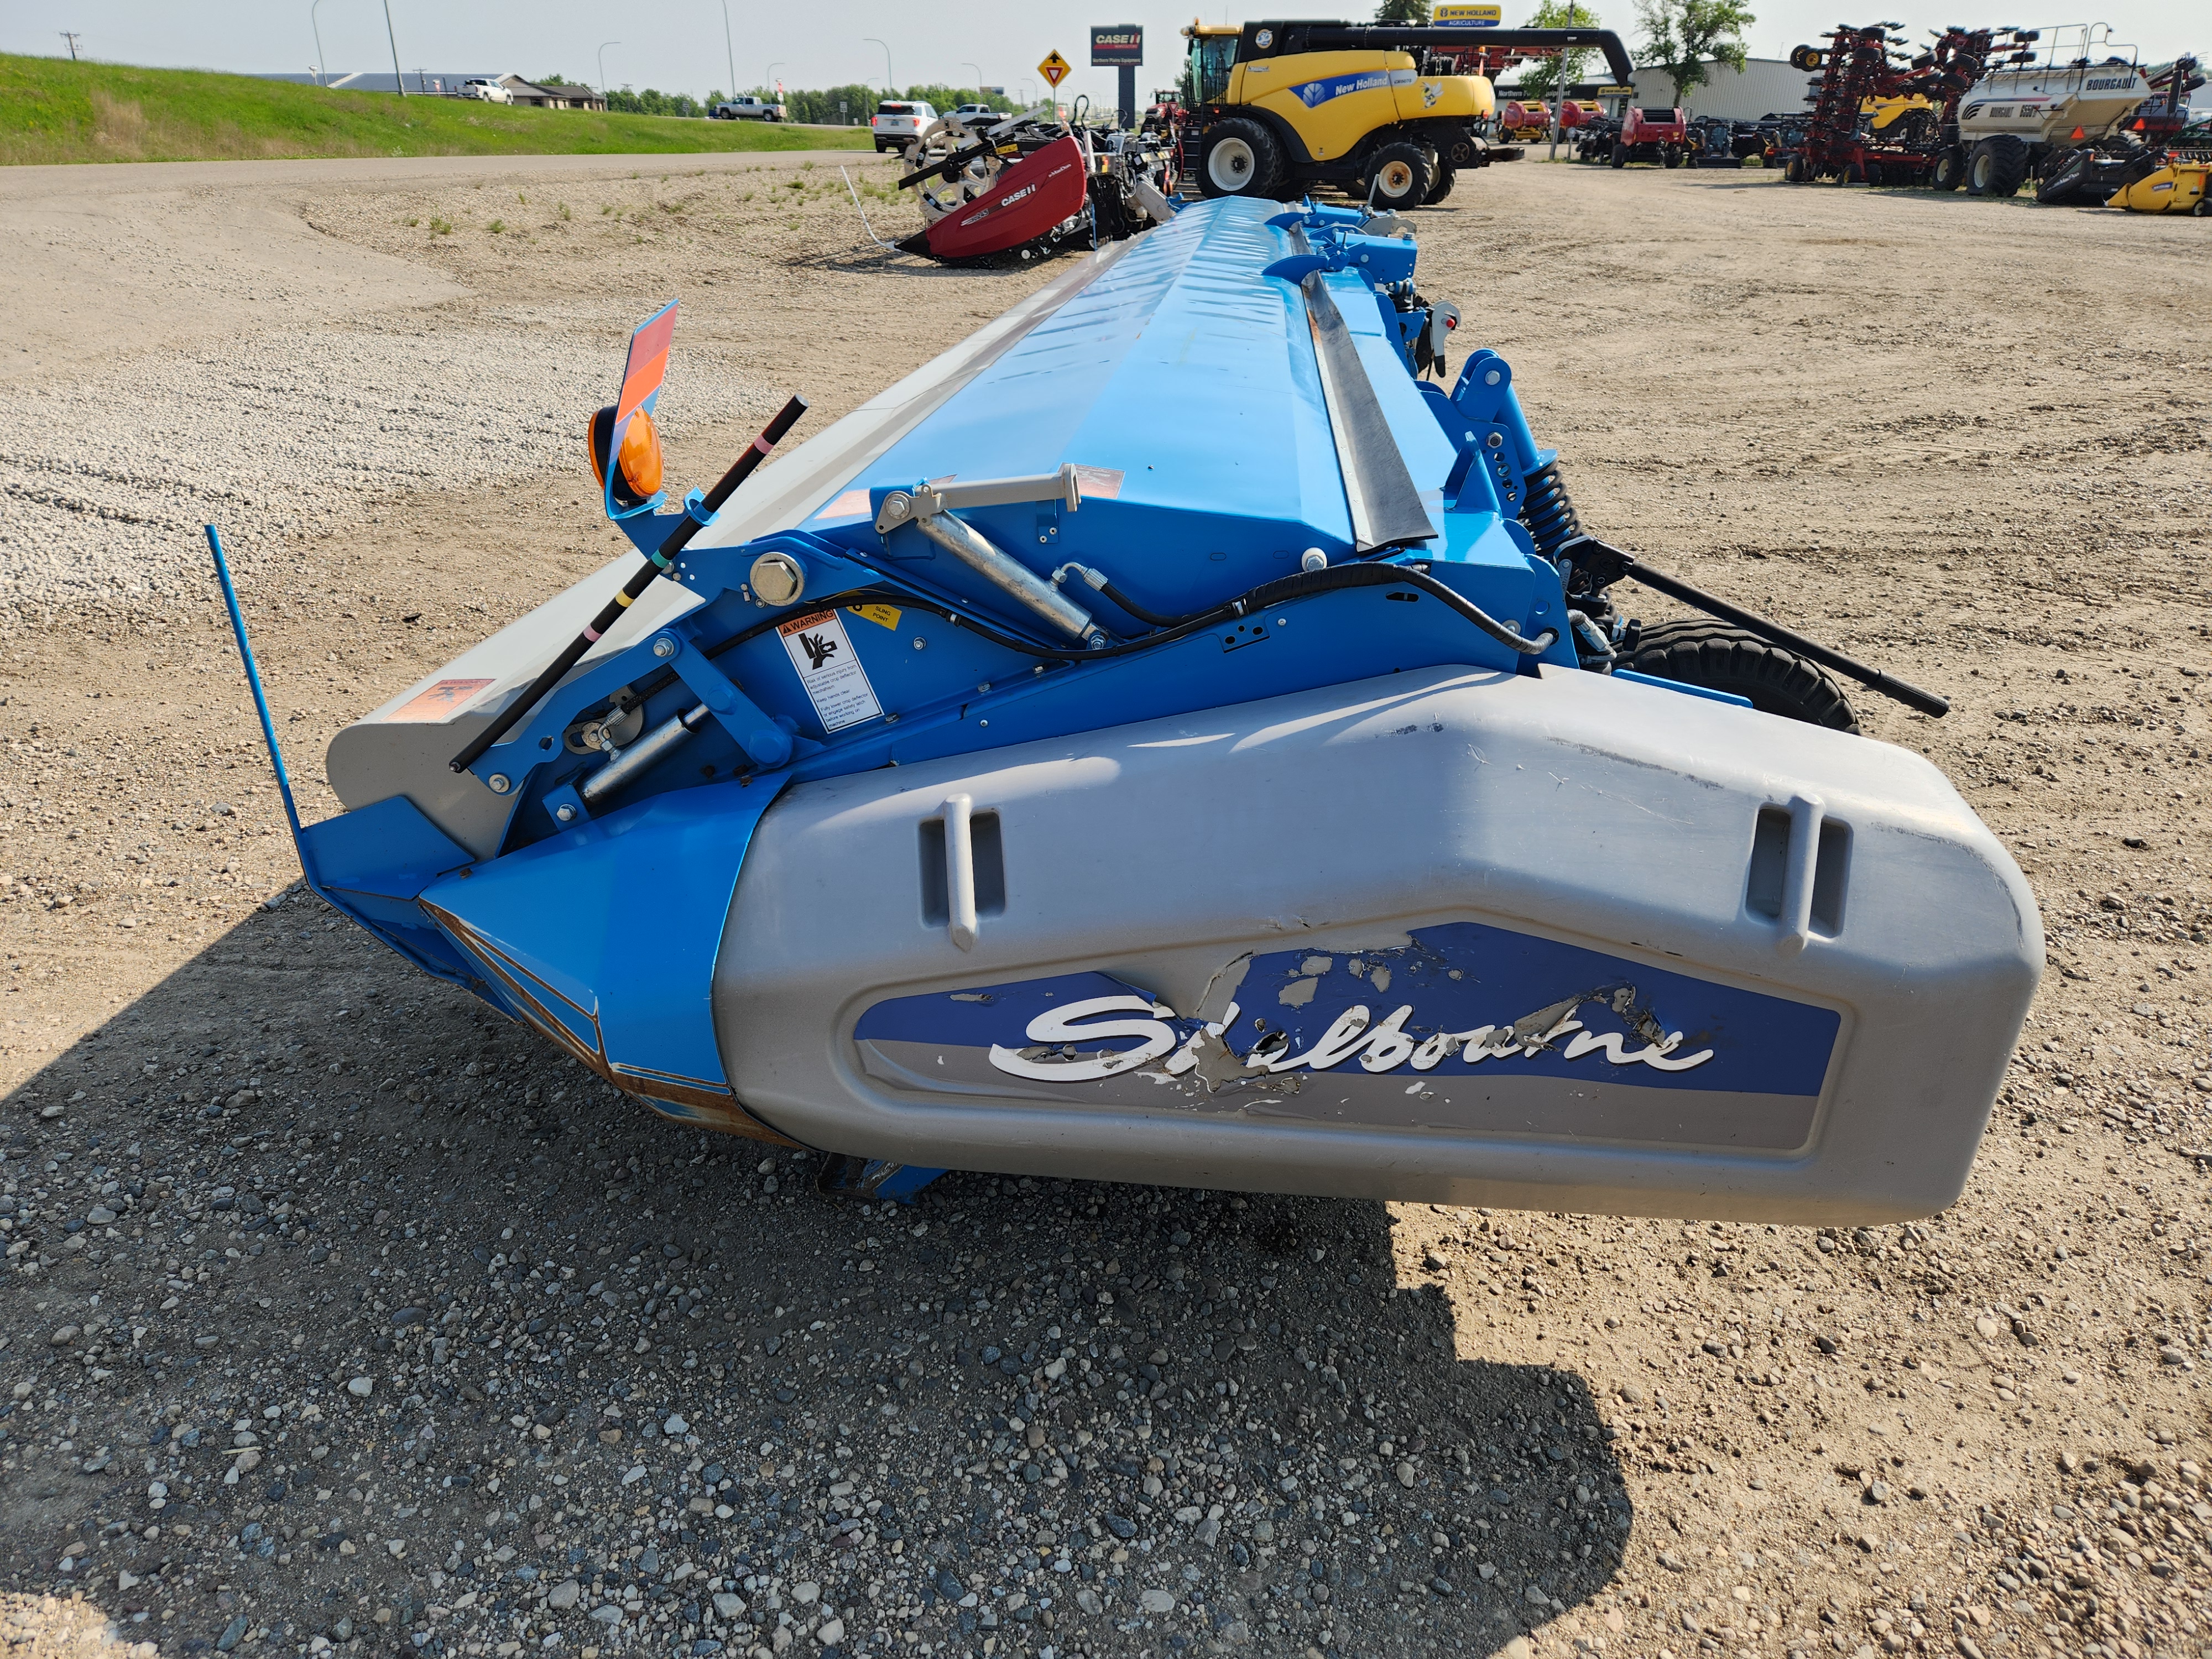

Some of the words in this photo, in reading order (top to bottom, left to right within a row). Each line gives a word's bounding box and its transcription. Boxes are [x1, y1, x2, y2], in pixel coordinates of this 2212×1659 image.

[1095, 34, 1129, 44] CASE
[1335, 83, 1355, 96] New
[1356, 75, 1388, 90] Holland
[2086, 77, 2138, 91] BOURGAULT
[1052, 163, 1072, 176] MacDon
[1001, 188, 1027, 207] CASE
[875, 606, 891, 616] SLING
[790, 610, 833, 630] WARNING
[873, 612, 889, 622] POINT
[836, 667, 847, 676] injury
[810, 680, 830, 690] adjustable
[839, 670, 857, 680] deflector
[812, 685, 835, 695] mechanism
[852, 692, 869, 701] deflector
[838, 710, 854, 718] working
[828, 719, 846, 728] machine
